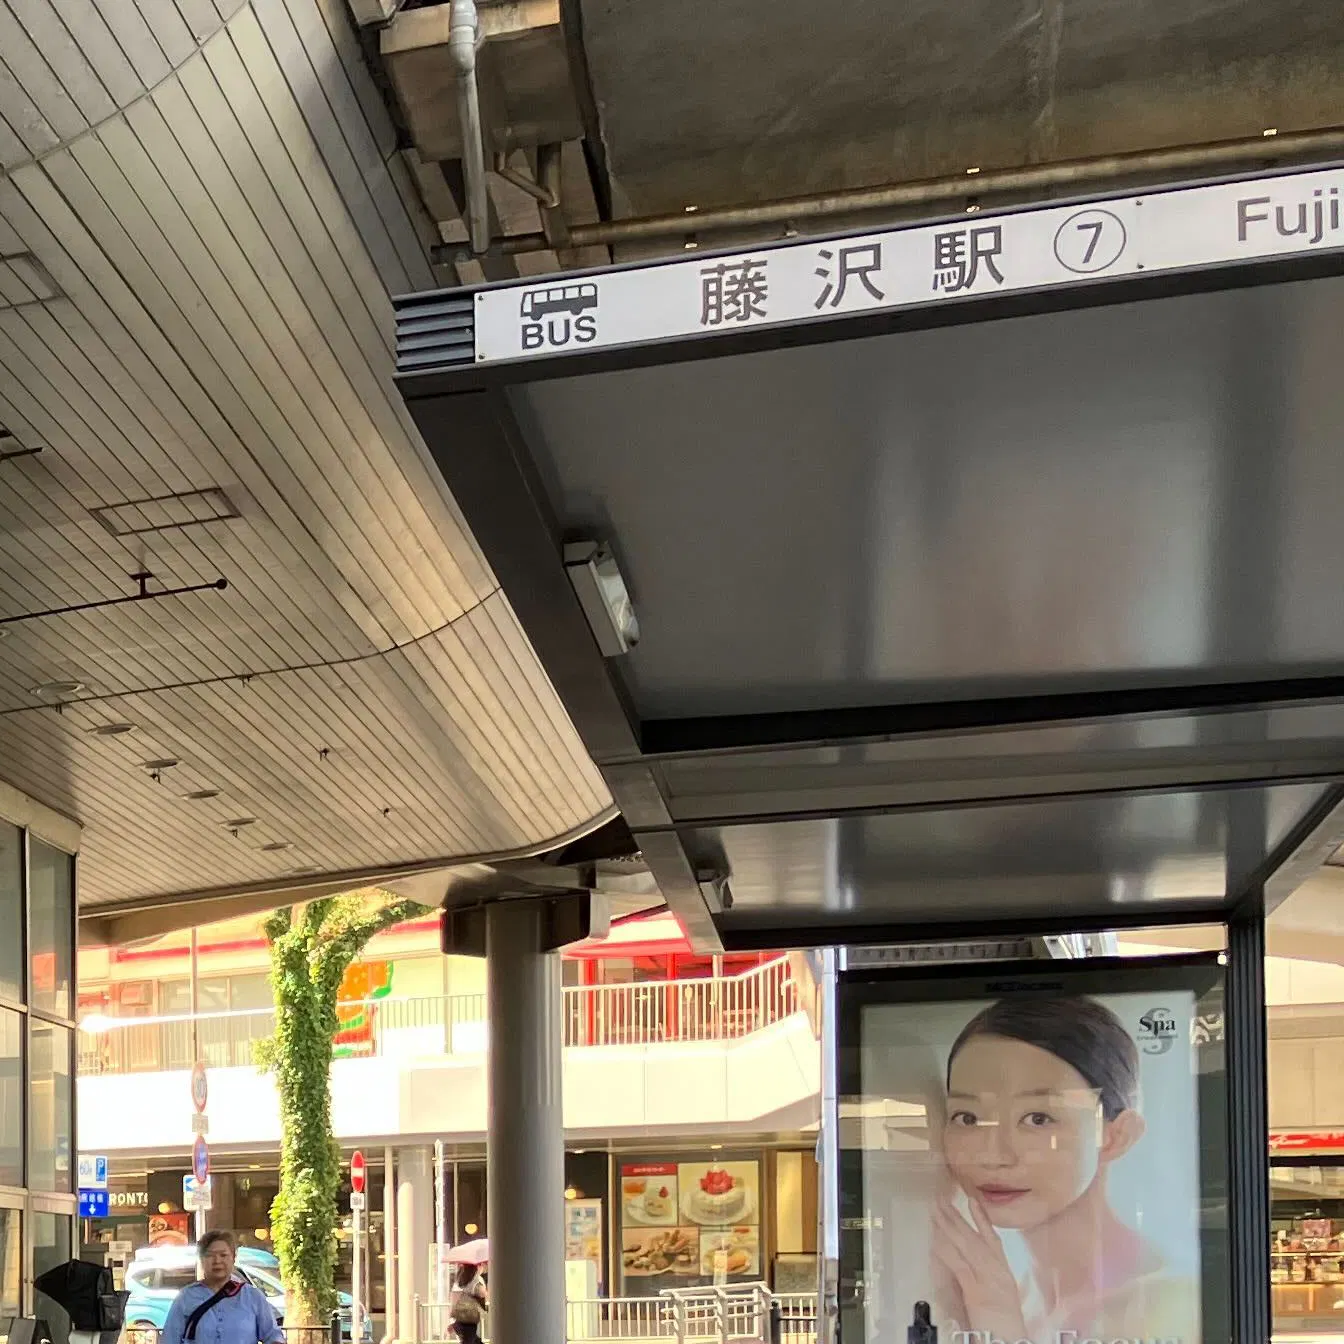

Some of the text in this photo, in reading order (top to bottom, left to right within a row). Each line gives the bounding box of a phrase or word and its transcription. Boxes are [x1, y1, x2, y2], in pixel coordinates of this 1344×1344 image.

[698, 224, 1006, 327] 藤沢駅
[1234, 186, 1340, 246] Fuji
[520, 314, 599, 351] BUS
[1139, 1016, 1177, 1037] Spa
